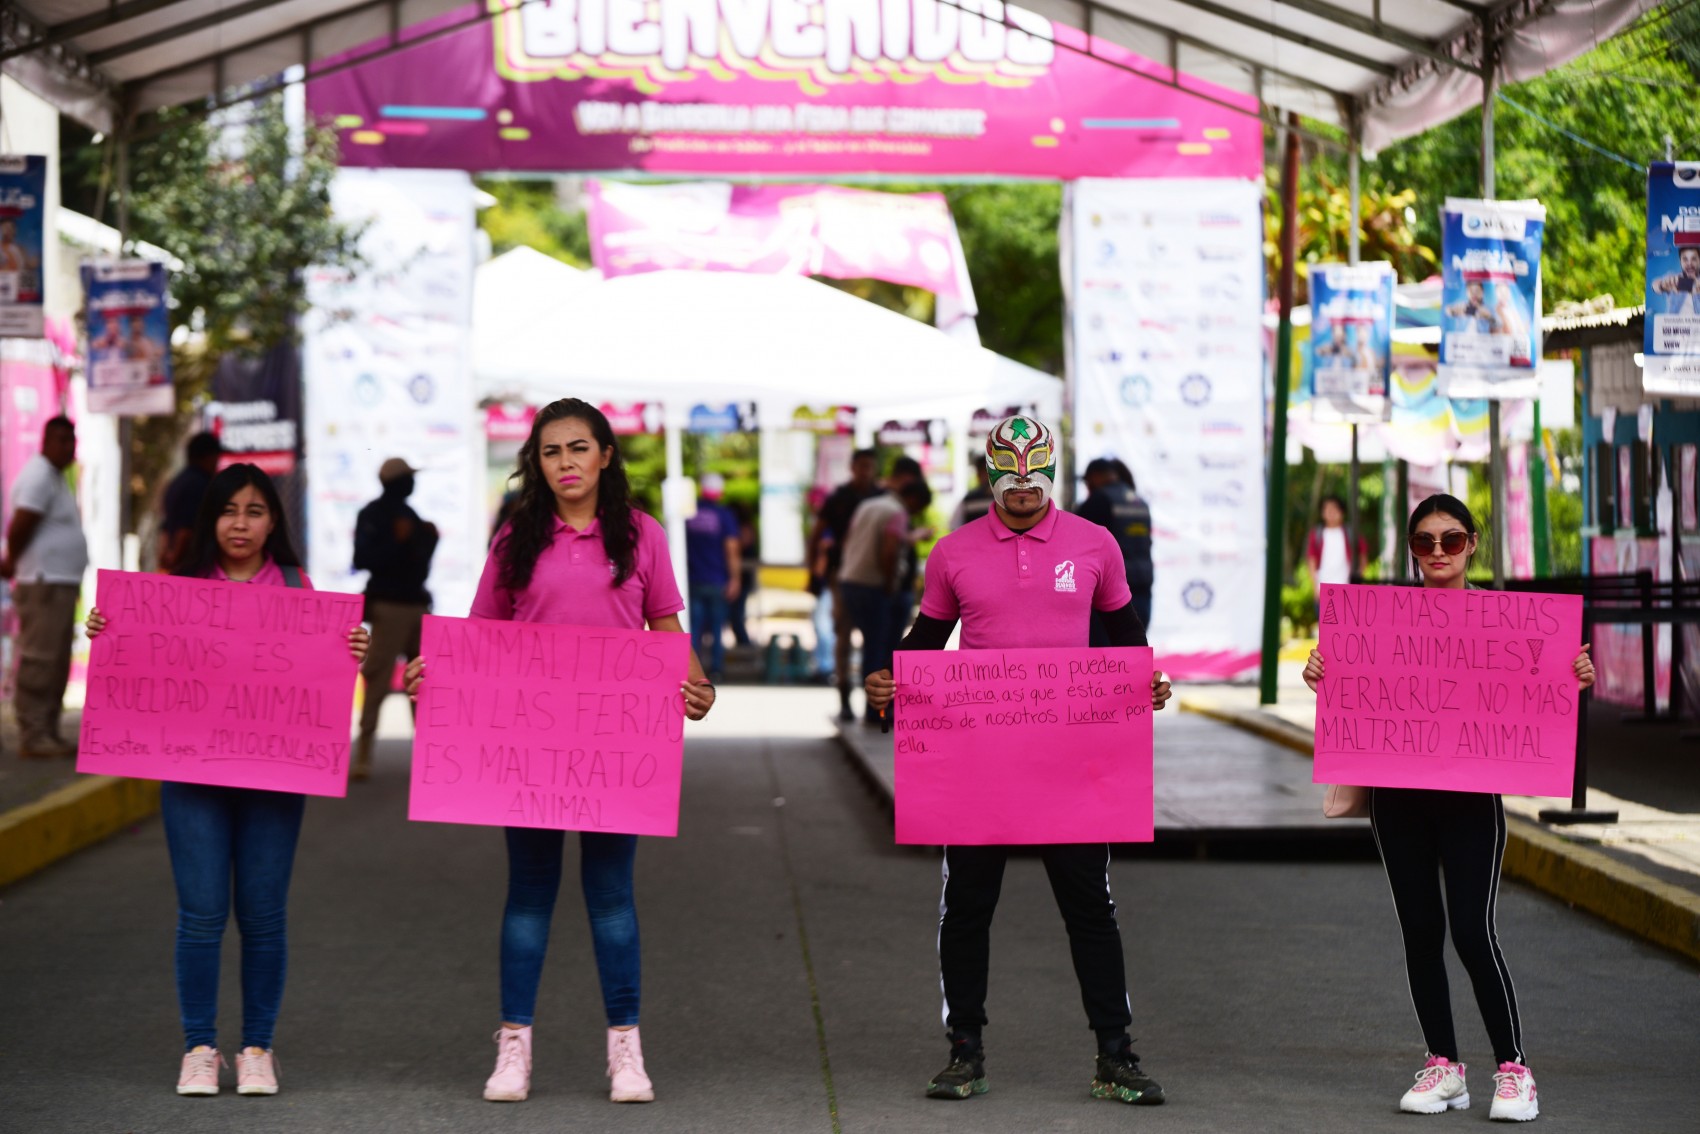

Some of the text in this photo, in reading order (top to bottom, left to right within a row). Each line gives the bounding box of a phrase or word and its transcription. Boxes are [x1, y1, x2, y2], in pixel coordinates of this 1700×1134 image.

[520, 0, 1056, 73] BIENVENIDOS
[103, 578, 236, 631] CARRUSEL
[1392, 589, 1449, 629] MÁS
[1465, 593, 1559, 635] FERIAS
[96, 631, 293, 673] DE PONYS ES
[431, 624, 665, 683] ANIMALITOS
[899, 654, 1131, 687] Los animales no pueden
[1331, 632, 1376, 665] CON
[87, 675, 333, 730] CRUELDAD ANIMAL
[428, 686, 684, 744] EN LAS FERIAS
[898, 691, 934, 714] pedir
[1002, 688, 1026, 703] así
[1030, 688, 1057, 708] que
[1067, 680, 1107, 698] está
[1113, 682, 1135, 695] en
[898, 703, 1151, 731] manos de nosotros luchar por
[1321, 675, 1573, 716] VERACRUZ NO MÁS
[1321, 716, 1551, 760] MALTRATO ANIMAL
[421, 741, 658, 789] ES MALTRATO
[507, 790, 616, 829] ANIMAL
